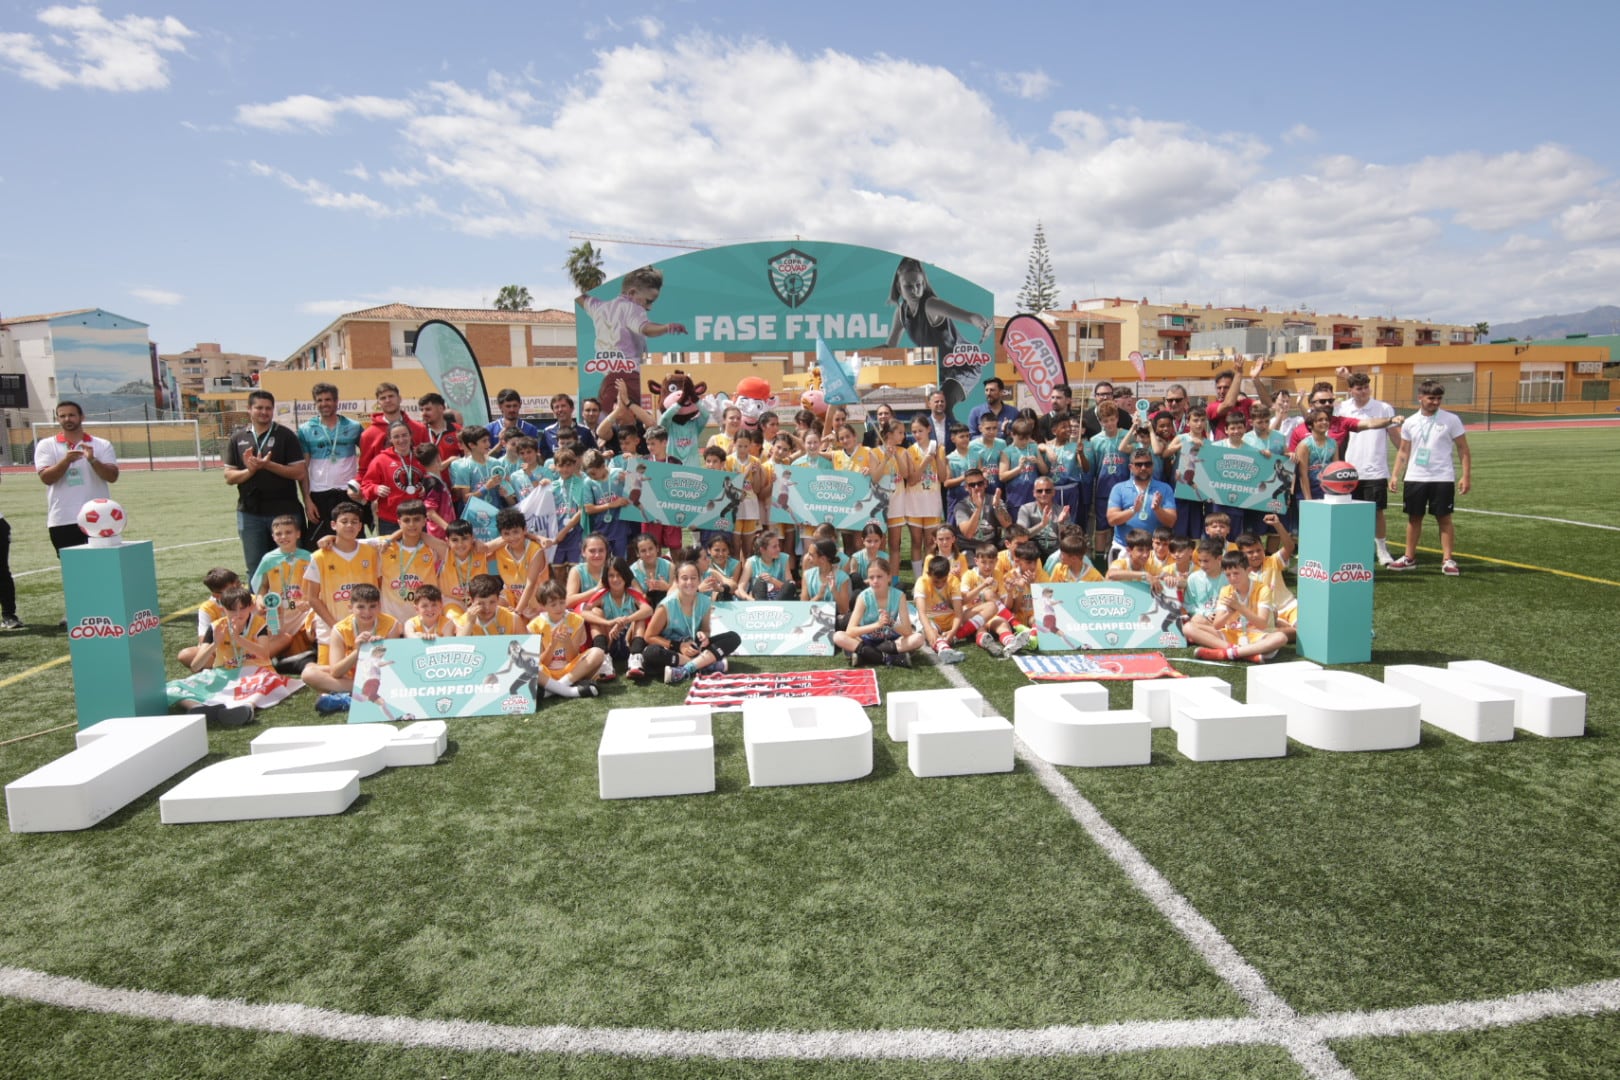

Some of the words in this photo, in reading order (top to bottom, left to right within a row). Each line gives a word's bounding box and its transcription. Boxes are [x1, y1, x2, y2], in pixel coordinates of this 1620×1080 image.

[778, 264, 807, 272] COVAP
[695, 314, 779, 341] FASE
[786, 313, 889, 340] FINAL
[954, 344, 980, 354] COPA
[596, 351, 625, 360] COPA
[944, 352, 991, 367] COVAP
[584, 358, 637, 373] COVAP
[1222, 470, 1252, 480] COVAP
[670, 489, 700, 500] COVAP
[816, 492, 847, 500] COVAP
[1305, 560, 1322, 570] COPA
[1341, 563, 1363, 572] COPA
[1300, 567, 1328, 581] COVAP
[1331, 570, 1372, 583] COVAP
[134, 610, 152, 621] COPA
[1090, 608, 1128, 616] COVAP
[81, 617, 112, 626] COPA
[128, 616, 160, 638] COVAP
[1067, 622, 1154, 632] SUBCAMPEONES
[70, 625, 125, 640] COVAP
[416, 651, 484, 670] CAMPUS
[426, 667, 472, 679] COVAP
[390, 684, 500, 698] SUBCAMPEONES
